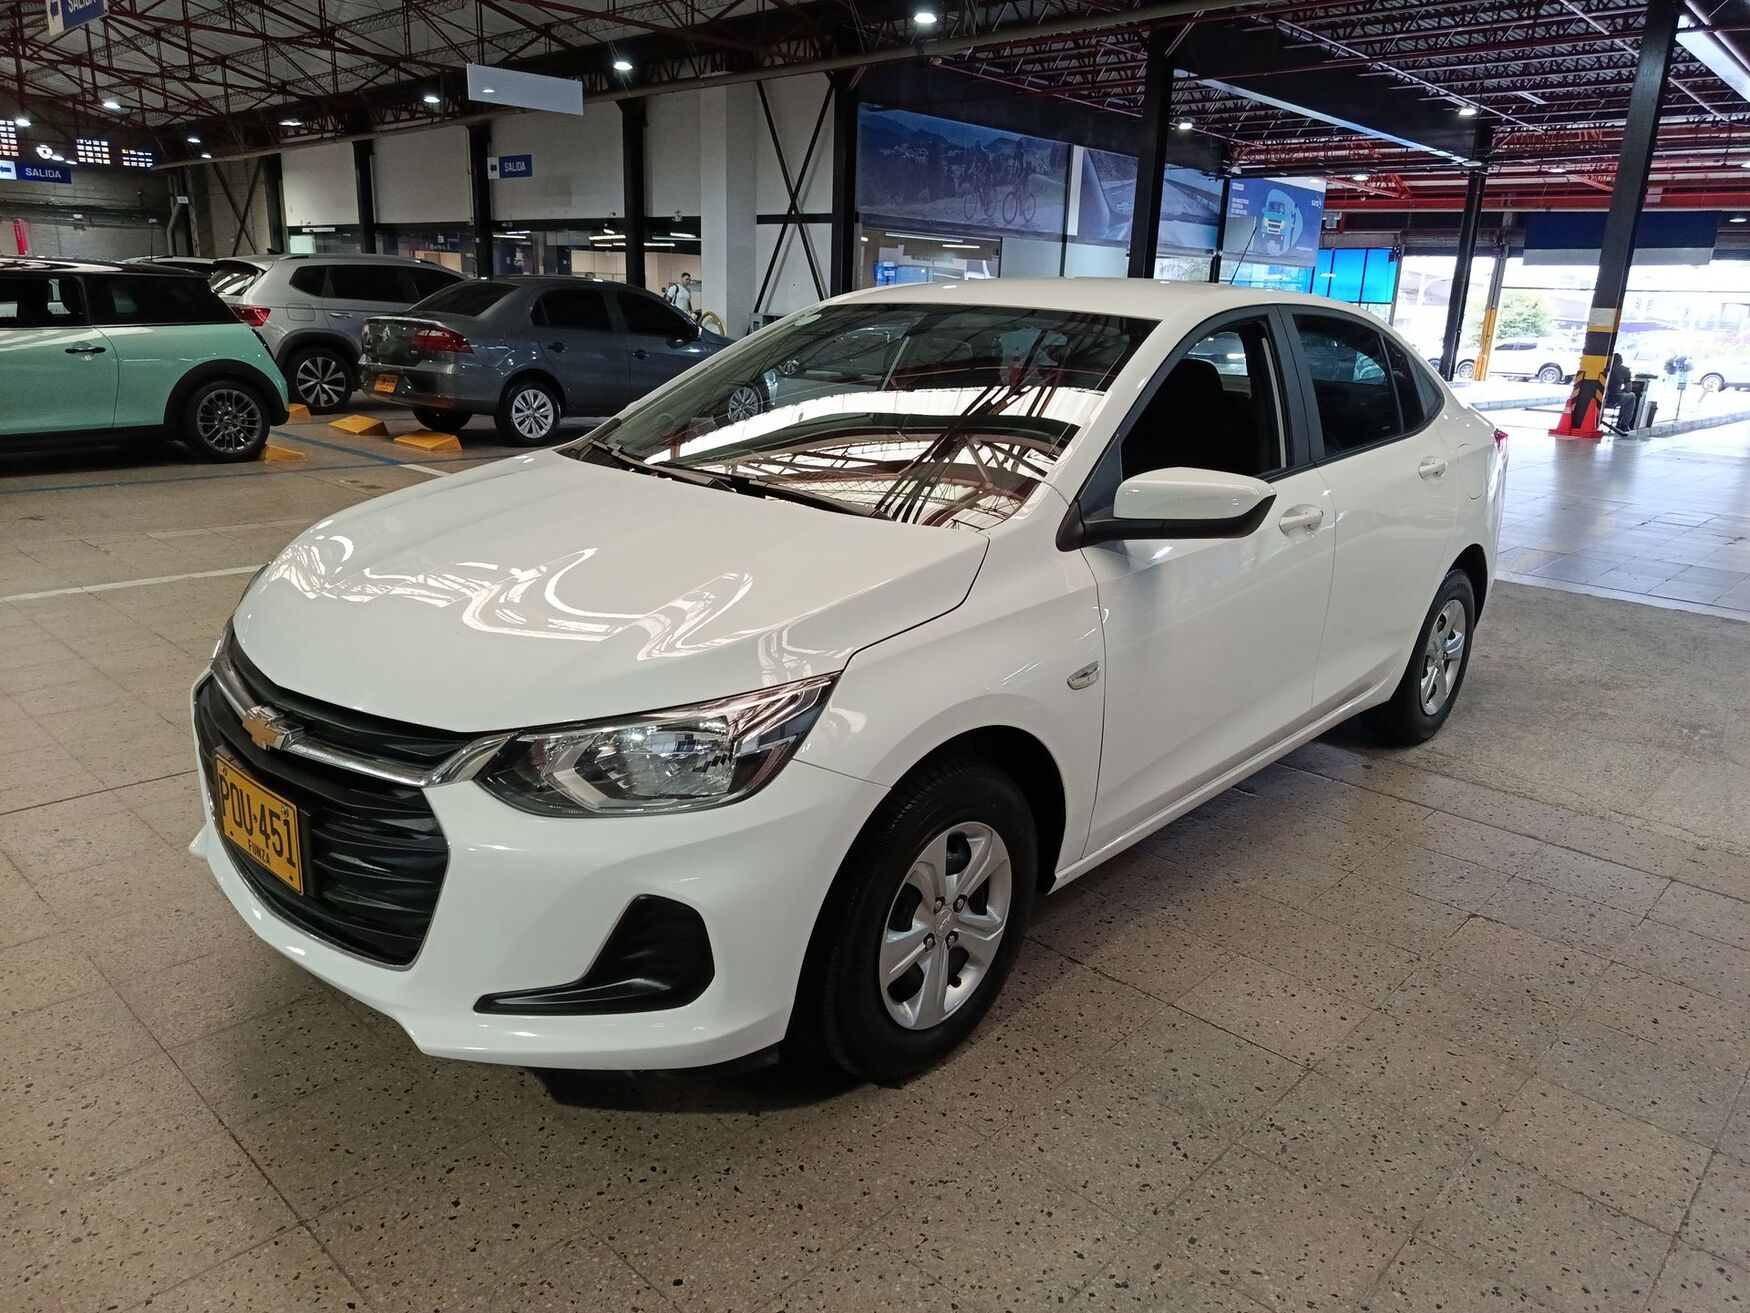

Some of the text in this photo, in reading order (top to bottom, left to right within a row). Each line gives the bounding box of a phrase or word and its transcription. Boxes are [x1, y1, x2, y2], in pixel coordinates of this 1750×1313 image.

[68, 0, 97, 13] SAL
[25, 166, 62, 179] SALIDA
[504, 160, 526, 172] SALIDA
[247, 838, 271, 866] FUNZA
